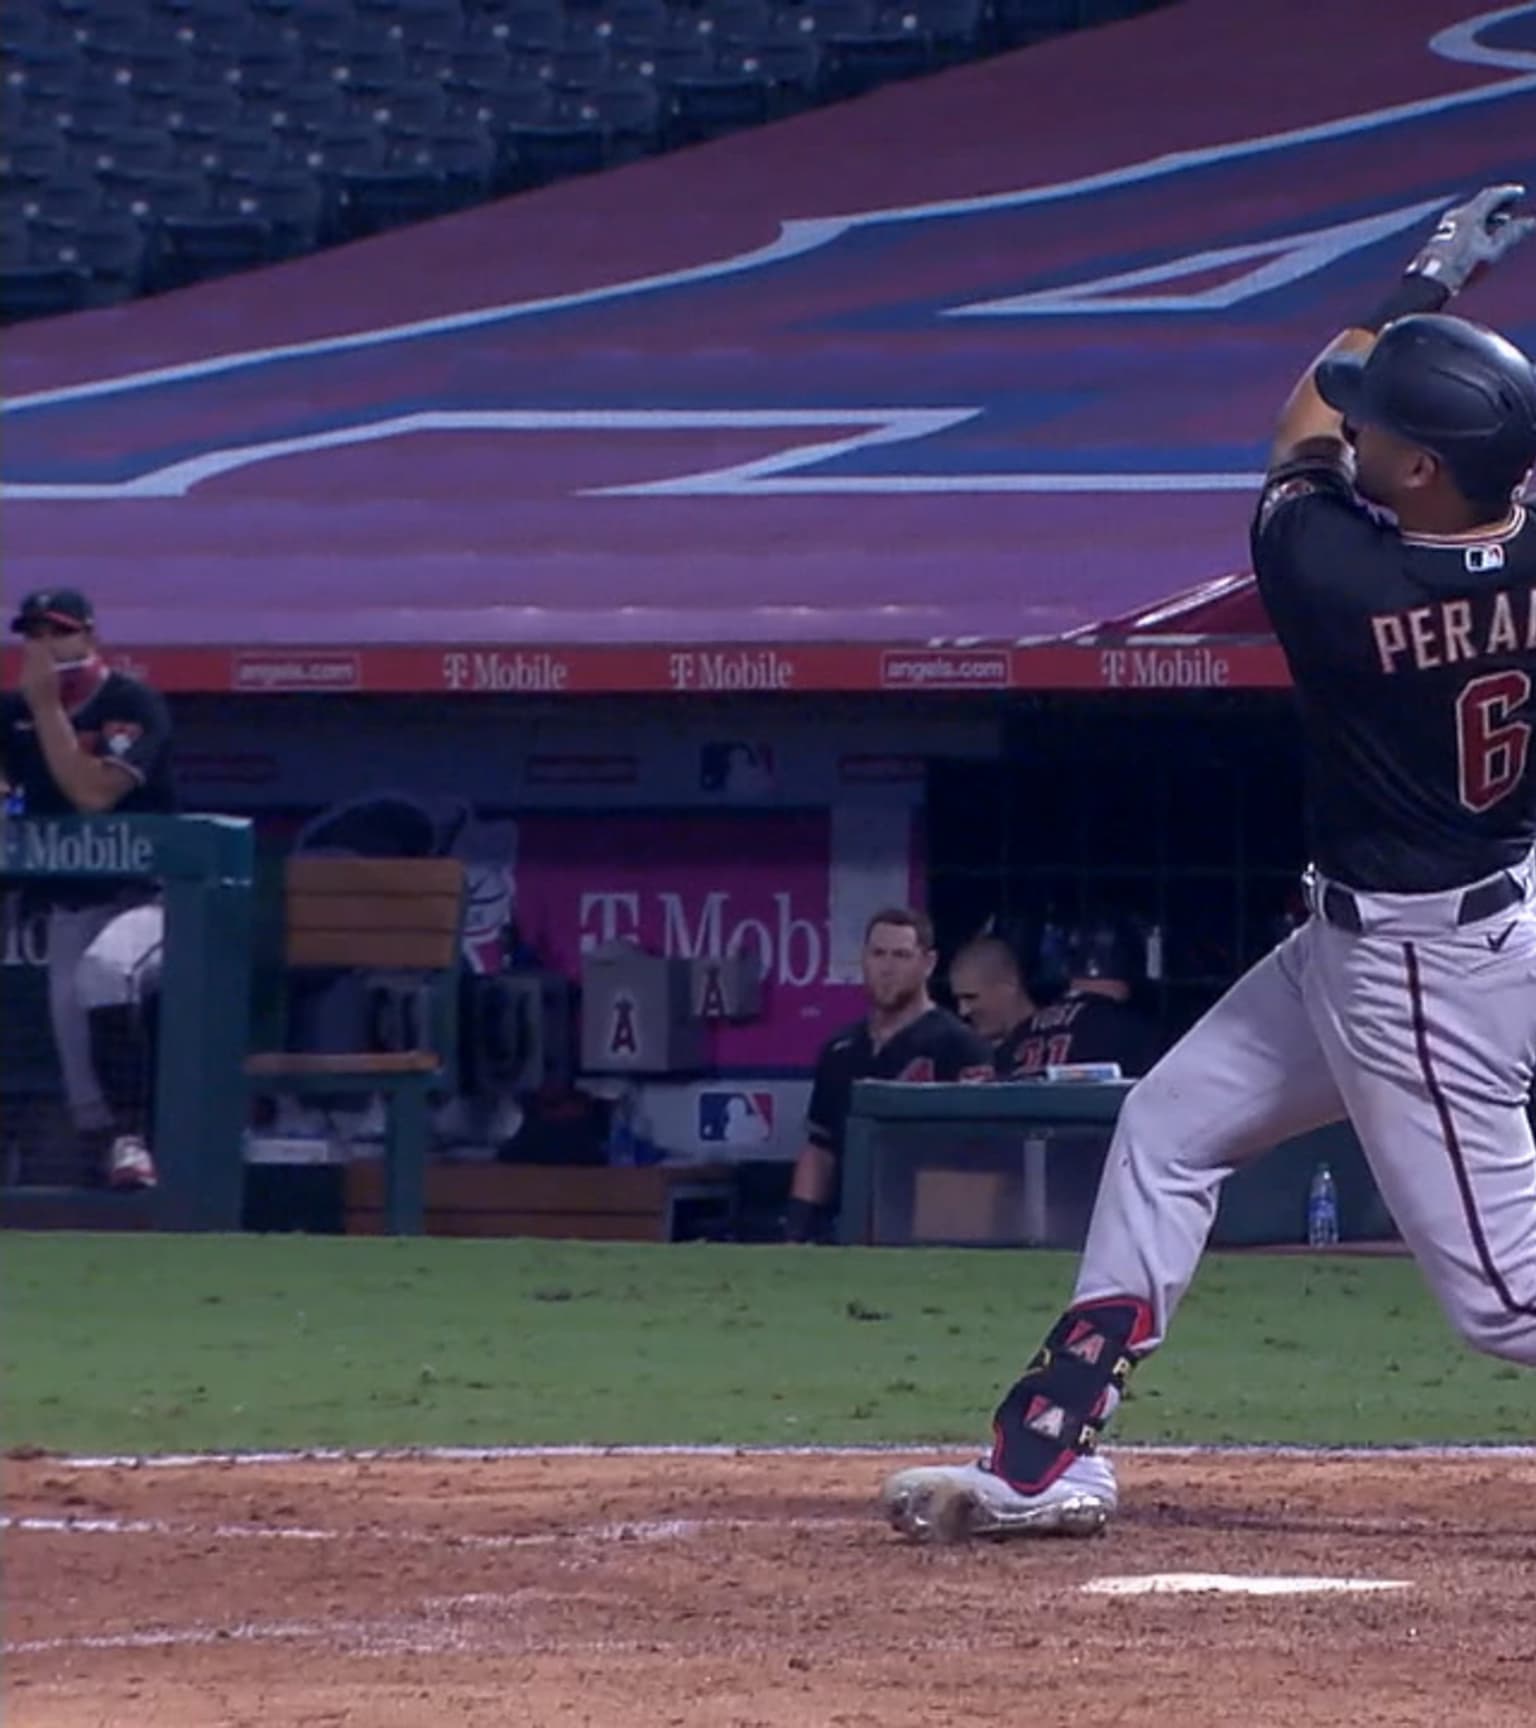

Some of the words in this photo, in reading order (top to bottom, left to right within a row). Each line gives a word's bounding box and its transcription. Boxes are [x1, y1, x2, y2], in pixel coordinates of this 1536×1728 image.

[474, 653, 566, 689] Mobile
[700, 652, 793, 689] Mobile
[887, 658, 1004, 681] angels.com
[1131, 650, 1230, 687] Mobile
[1456, 669, 1532, 814] 6
[23, 822, 152, 871] Mobile
